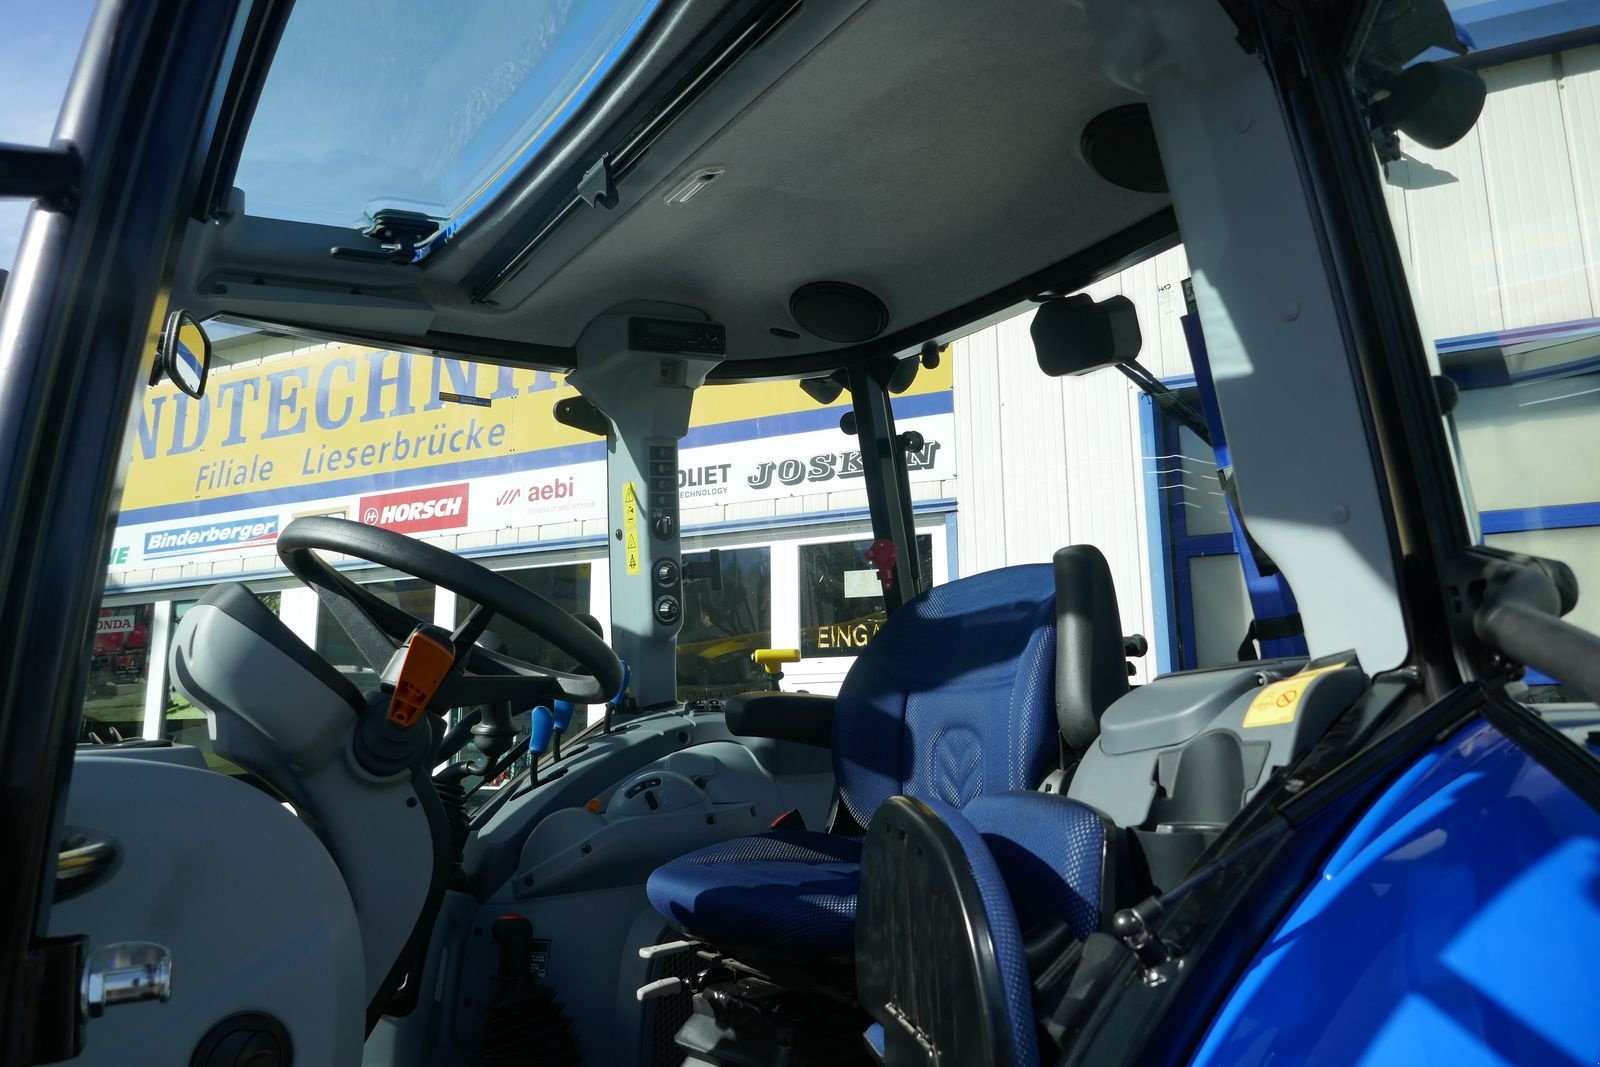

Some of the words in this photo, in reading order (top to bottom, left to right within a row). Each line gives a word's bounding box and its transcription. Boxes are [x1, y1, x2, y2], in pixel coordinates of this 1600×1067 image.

[195, 454, 274, 492] Filiale
[302, 418, 506, 476] Lieserbrücke
[747, 440, 941, 489] JOSKN
[528, 476, 573, 502] aebi
[380, 497, 463, 525] HORSCH
[147, 519, 275, 550] Binderberger
